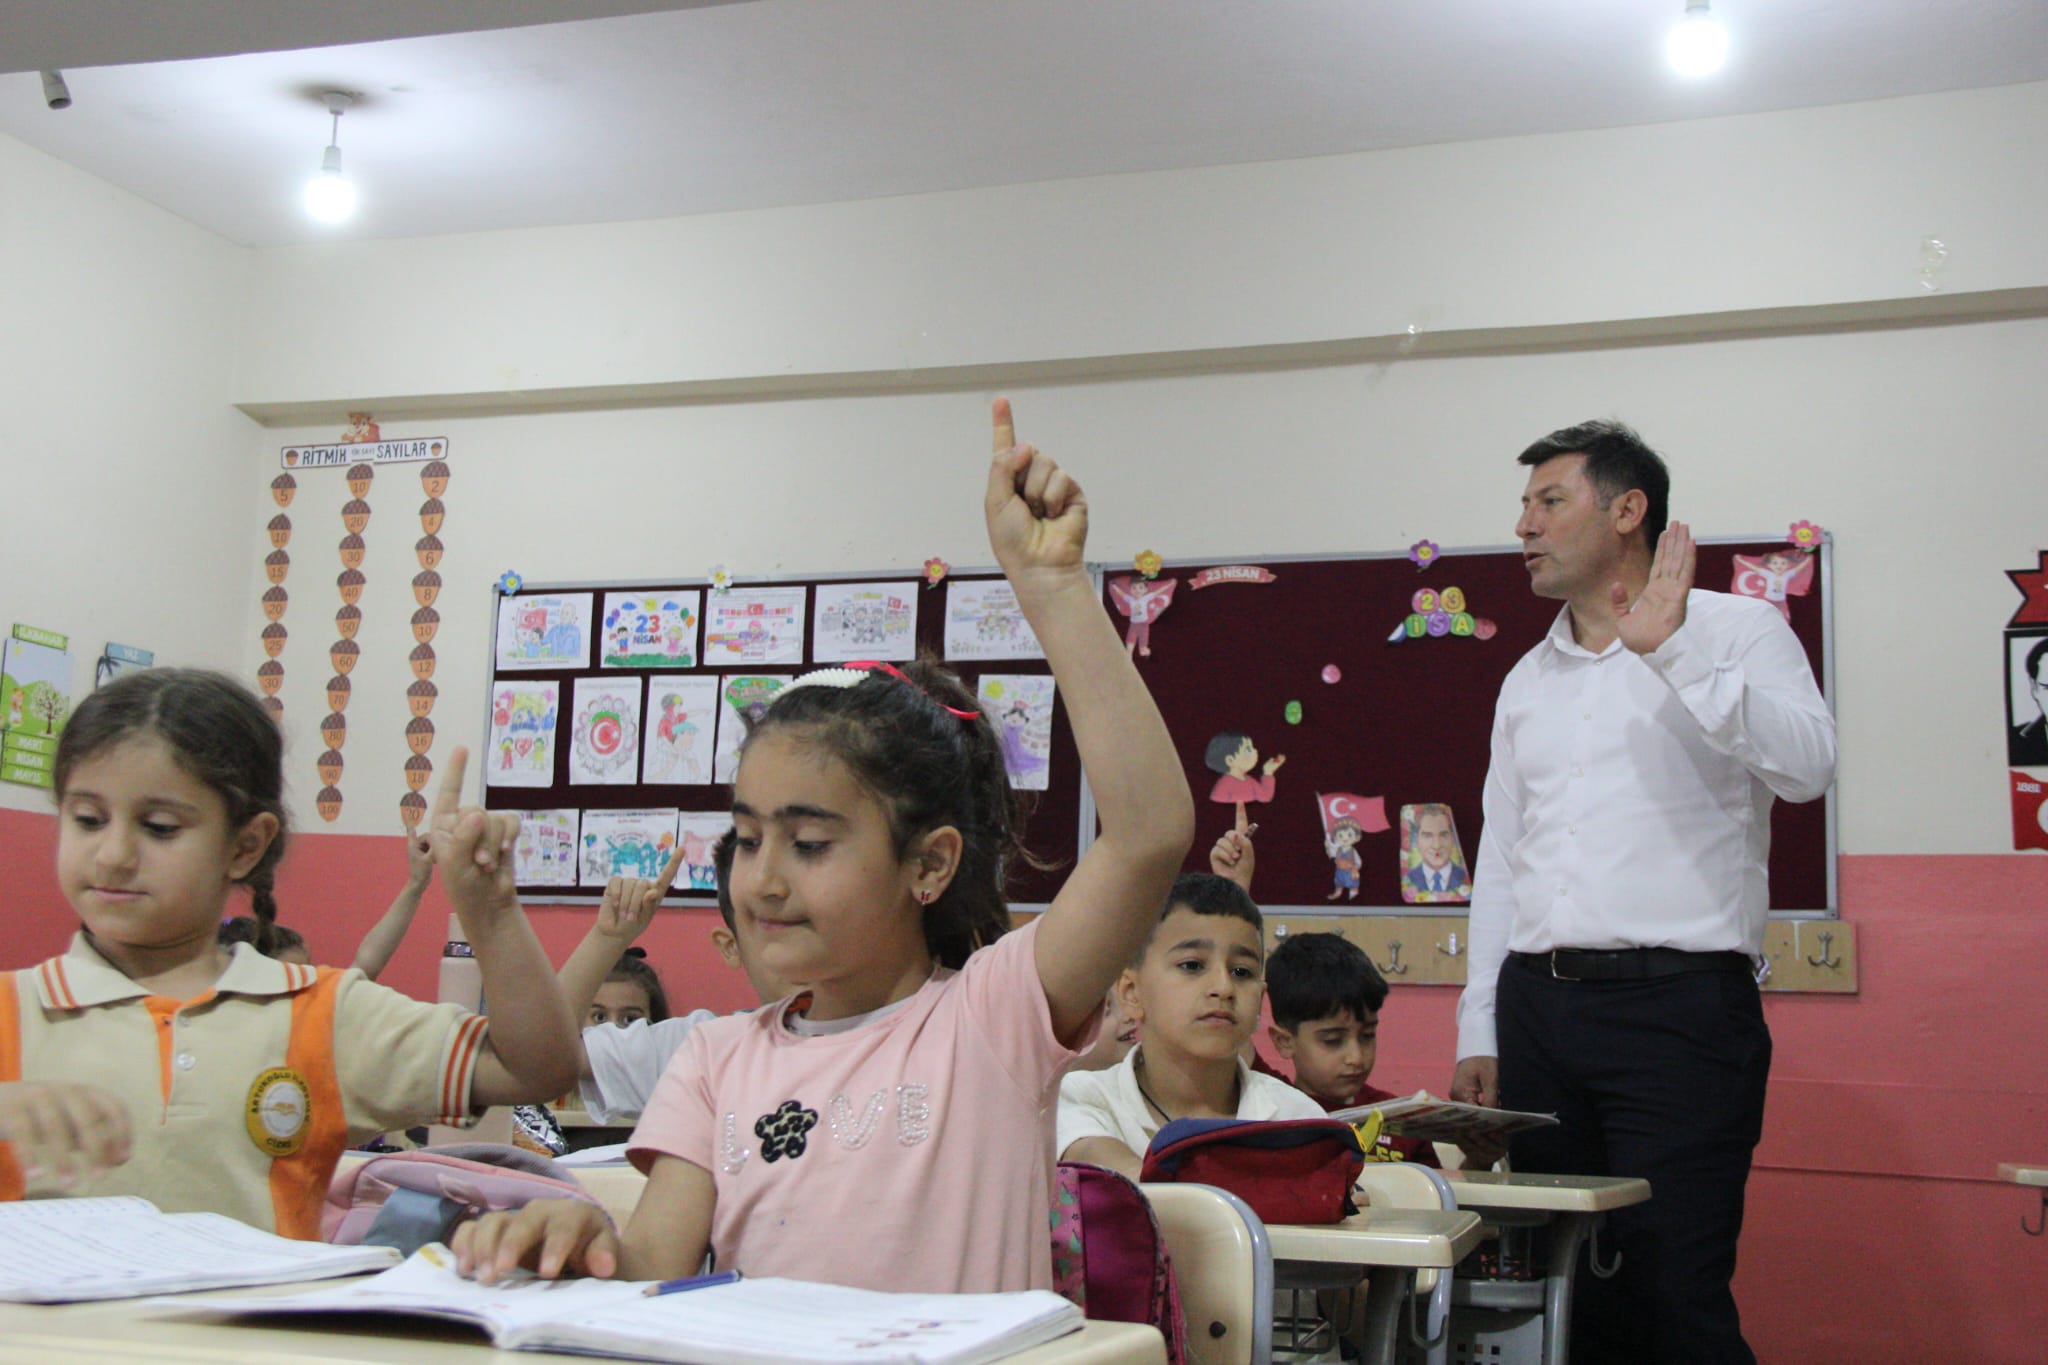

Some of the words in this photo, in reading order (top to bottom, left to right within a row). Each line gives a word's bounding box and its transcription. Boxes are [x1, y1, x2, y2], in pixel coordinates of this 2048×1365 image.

[302, 445, 347, 465] RİTMİK
[376, 442, 427, 459] SAYILAR
[353, 482, 365, 492] 10
[431, 481, 440, 492] 2
[280, 490, 288, 501] 5
[350, 517, 363, 527] 20
[275, 532, 287, 542] 10
[426, 552, 434, 564] 6
[271, 567, 284, 578] 15
[1206, 571, 1221, 581] 23
[1223, 568, 1260, 579] NİSAN
[424, 588, 432, 600] 8
[1421, 591, 1460, 610] 23
[269, 603, 281, 614] 20
[635, 614, 661, 633] 23
[419, 626, 431, 637] 10
[633, 633, 662, 644] NİSAN
[269, 640, 282, 650] 25
[339, 656, 352, 667] 60
[419, 661, 431, 672] 12
[265, 678, 278, 689] 30
[333, 694, 345, 705] 70
[415, 700, 428, 711] 14
[414, 737, 427, 746] 16
[411, 773, 424, 783] 18
[721, 1081, 929, 1175] LVE
